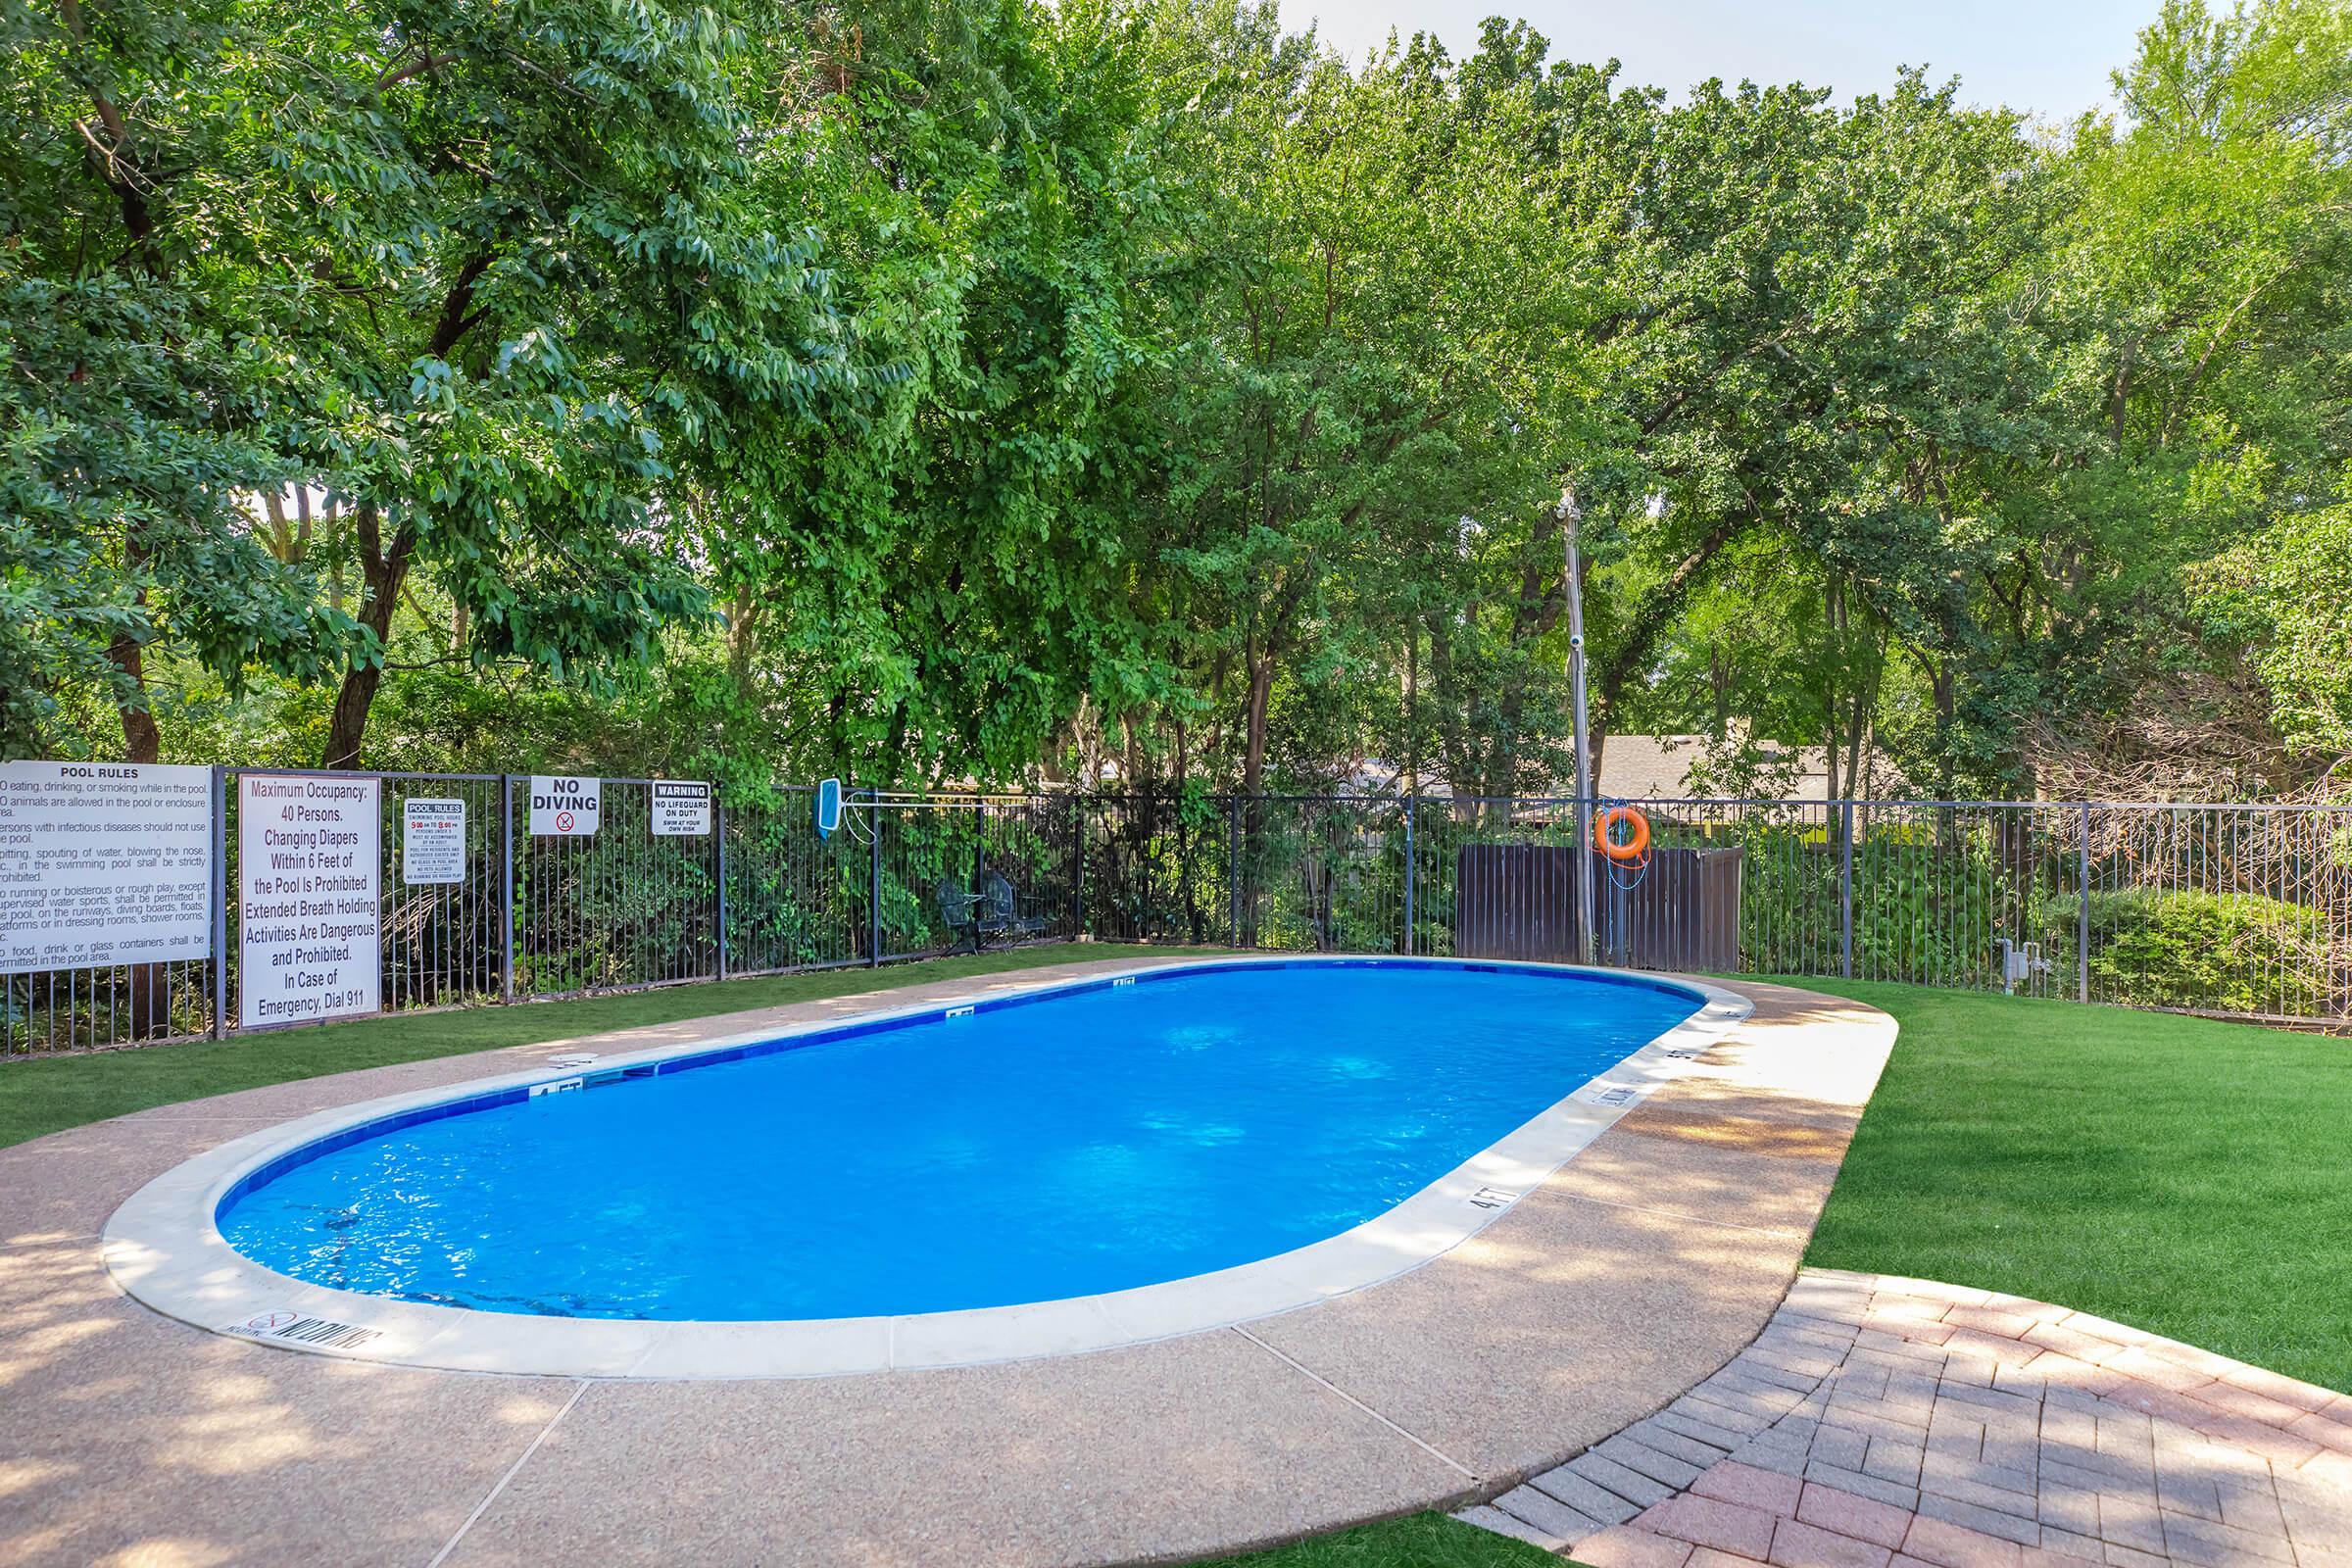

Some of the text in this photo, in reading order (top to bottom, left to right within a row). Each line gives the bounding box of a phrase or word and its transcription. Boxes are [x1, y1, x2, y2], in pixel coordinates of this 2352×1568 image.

[61, 767, 138, 778] POOL RULES
[100, 784, 137, 794] smoking
[174, 784, 186, 793] the
[252, 781, 367, 802] Maximum Occupancy:
[554, 780, 579, 793] NO
[658, 786, 705, 796] WARNING
[11, 797, 48, 806] animals
[68, 798, 103, 807] allowed
[106, 798, 114, 807] in
[117, 798, 130, 807] the
[133, 798, 151, 808] pool
[166, 799, 205, 807] enclosure
[533, 797, 596, 810] DIVING
[282, 805, 343, 821] 40 Persons.
[34, 823, 55, 832] with
[58, 823, 101, 832] infectious
[104, 823, 141, 831] diseases
[144, 823, 172, 831] should
[175, 823, 188, 831] not
[265, 829, 358, 849] Changing Diapers
[37, 849, 78, 861] spouting
[83, 848, 92, 857] of
[127, 848, 161, 858] blowing
[166, 847, 179, 856] the
[271, 852, 353, 869] Within 6 Feet of
[19, 861, 27, 869] in
[35, 861, 49, 869] the
[56, 859, 105, 870] swimming
[112, 858, 131, 869] pool
[137, 858, 157, 867] shall
[163, 858, 173, 866] be
[179, 858, 205, 867] strictly
[10, 887, 47, 899] running
[51, 887, 61, 896] or
[64, 886, 112, 895] boisterous
[128, 884, 154, 895] rough
[179, 883, 205, 893] except
[255, 875, 367, 894] the Pool Is Prohibited
[50, 898, 74, 907] water
[115, 895, 135, 904] shall
[139, 895, 150, 903] be
[154, 893, 193, 904] permitted
[198, 892, 205, 900] in
[55, 909, 68, 917] the
[117, 904, 143, 916] diving
[246, 898, 375, 919] Extended Breath Holding
[65, 917, 104, 928] dressing
[141, 914, 172, 923] shower
[246, 923, 375, 944] Activities Are Dangerous
[44, 944, 68, 954] drink
[75, 943, 83, 952] or
[91, 942, 113, 952] glass
[120, 938, 164, 949] containers
[169, 936, 188, 945] shall
[194, 936, 204, 944] be
[40, 956, 48, 965] in
[51, 955, 65, 964] the
[68, 954, 88, 965] pool
[272, 945, 351, 966] and Prohibited.
[285, 968, 338, 989] In Case of
[259, 989, 363, 1017] Emergency, Dial 911
[1470, 1187, 1517, 1208] 4 FT
